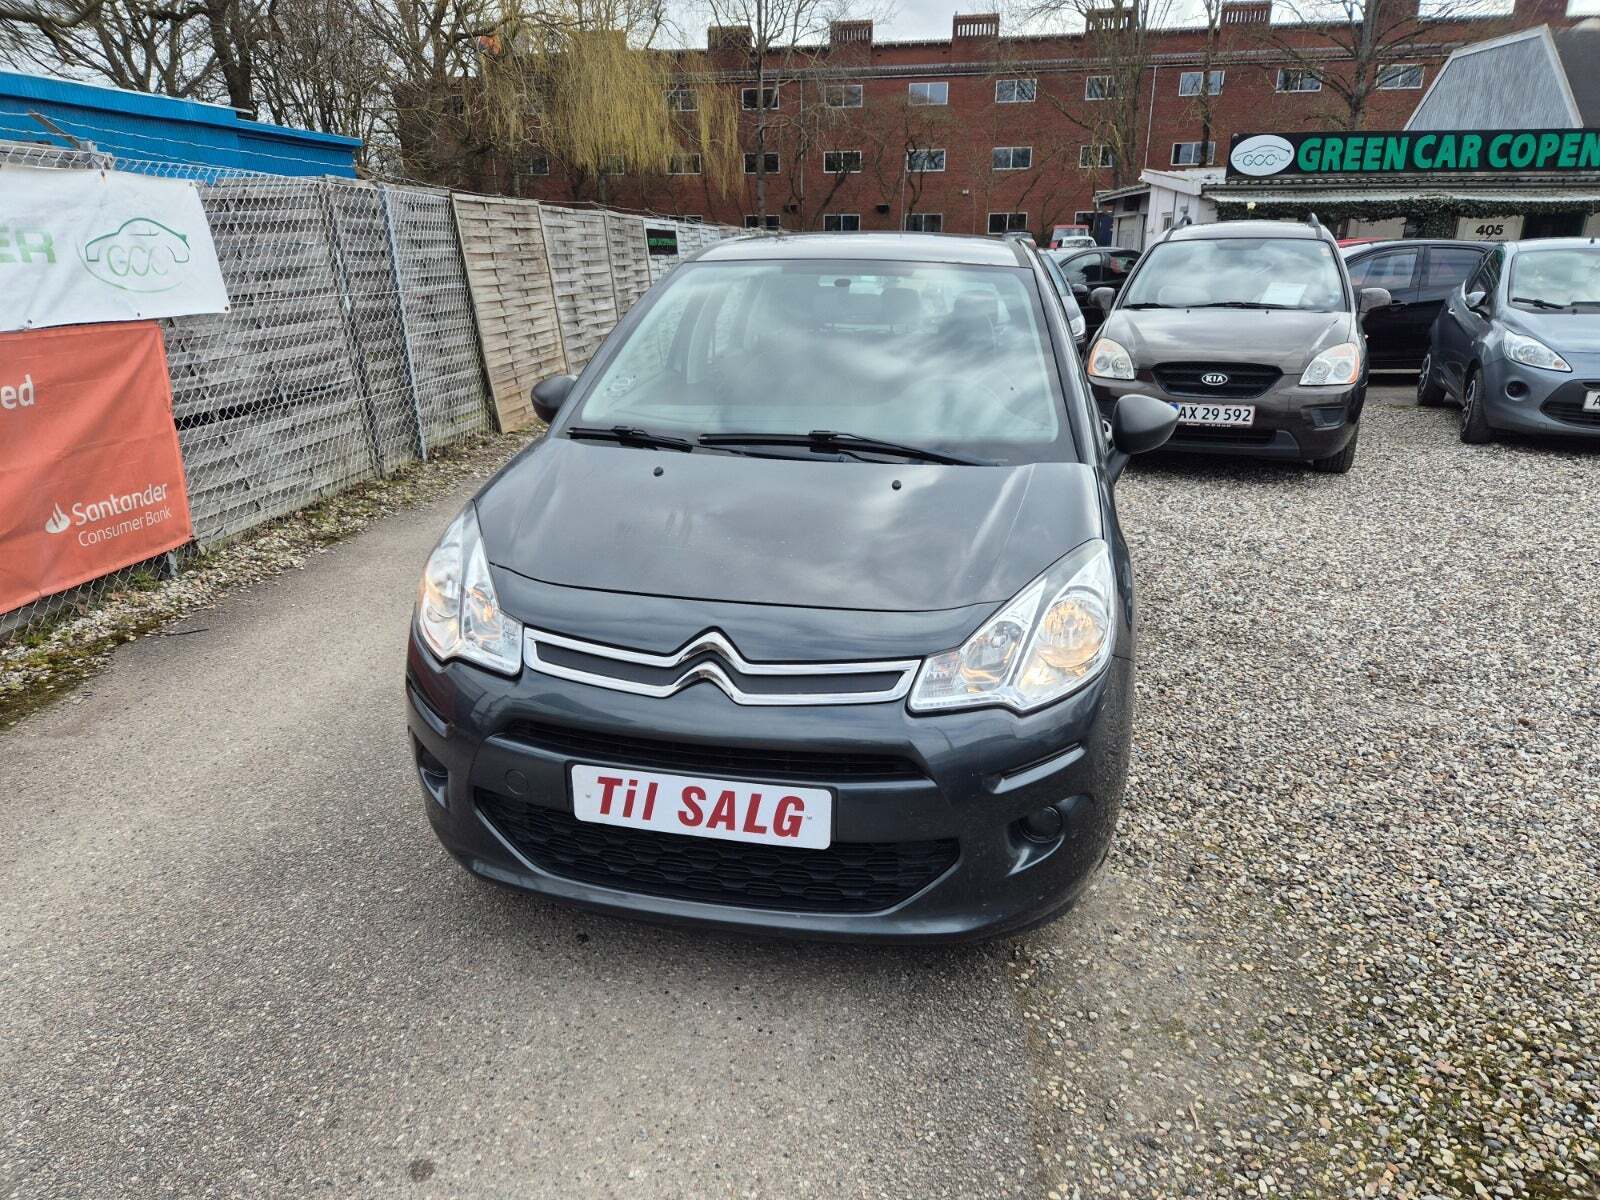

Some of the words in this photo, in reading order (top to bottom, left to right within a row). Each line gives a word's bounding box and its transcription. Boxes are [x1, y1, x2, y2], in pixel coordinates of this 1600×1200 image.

[1297, 136, 1409, 172] GREEN
[1413, 134, 1482, 170] CAR
[1488, 132, 1600, 168] COPEN
[1475, 224, 1504, 236] 405
[1179, 406, 1199, 420] AX
[1201, 407, 1220, 421] 29
[1223, 408, 1252, 422] 592
[71, 483, 168, 526] Santander
[78, 515, 145, 547] Consumer
[146, 504, 172, 525] Bank
[677, 785, 806, 838] SALG
